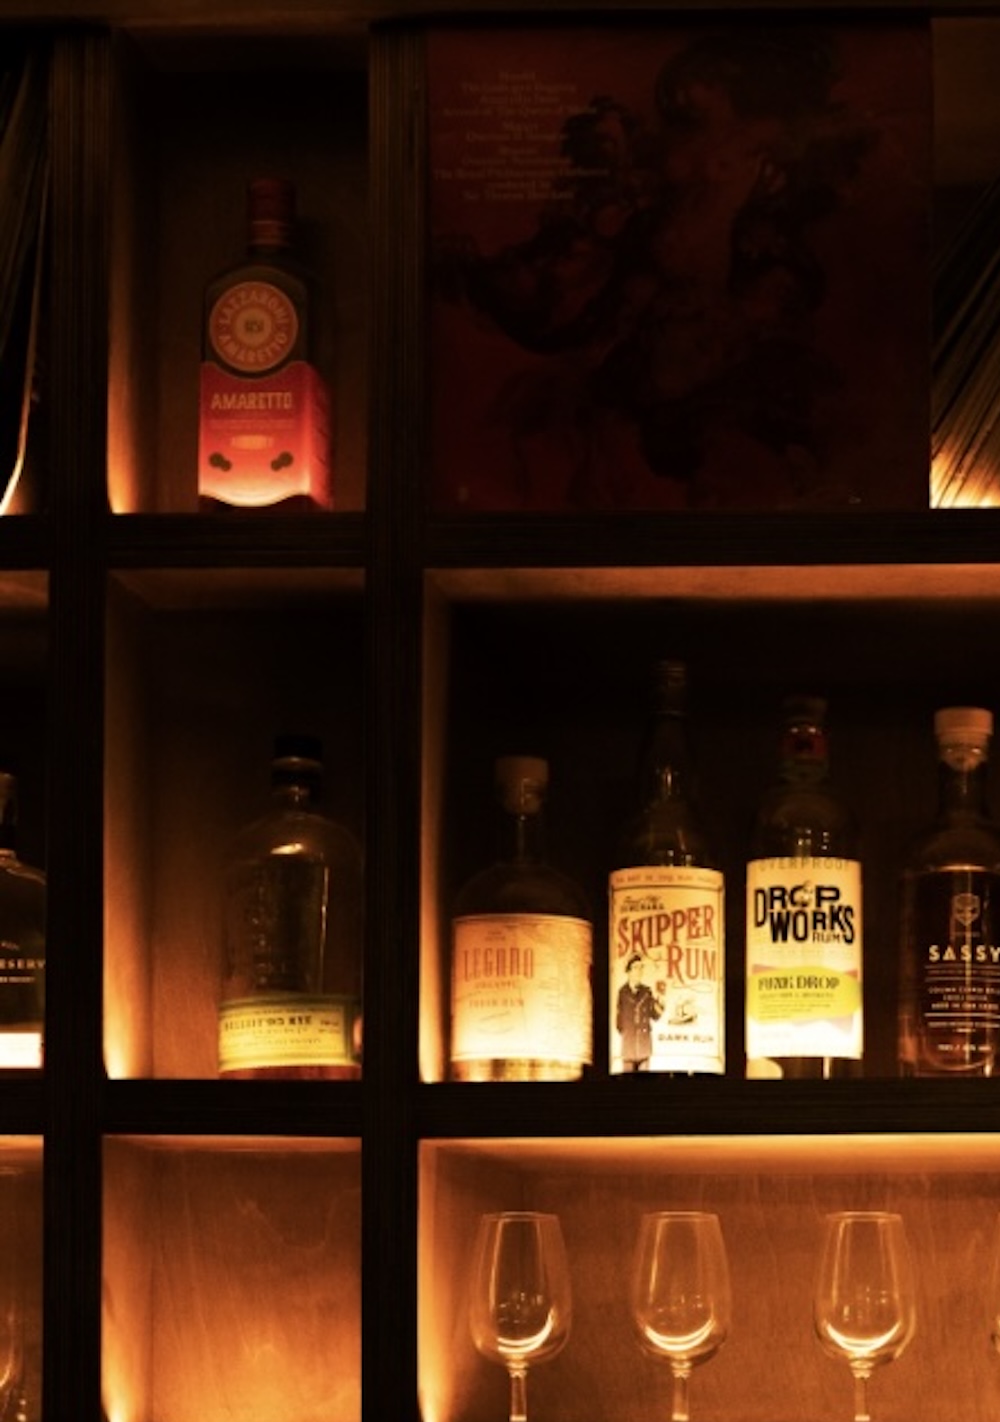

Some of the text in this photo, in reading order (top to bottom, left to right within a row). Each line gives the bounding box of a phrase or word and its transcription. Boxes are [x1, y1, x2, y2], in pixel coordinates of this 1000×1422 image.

[211, 391, 292, 410] AMARETTO
[754, 880, 842, 928] DROP
[770, 904, 855, 944] WORKS
[618, 904, 715, 958] SKIPPER
[667, 943, 717, 984] RUM
